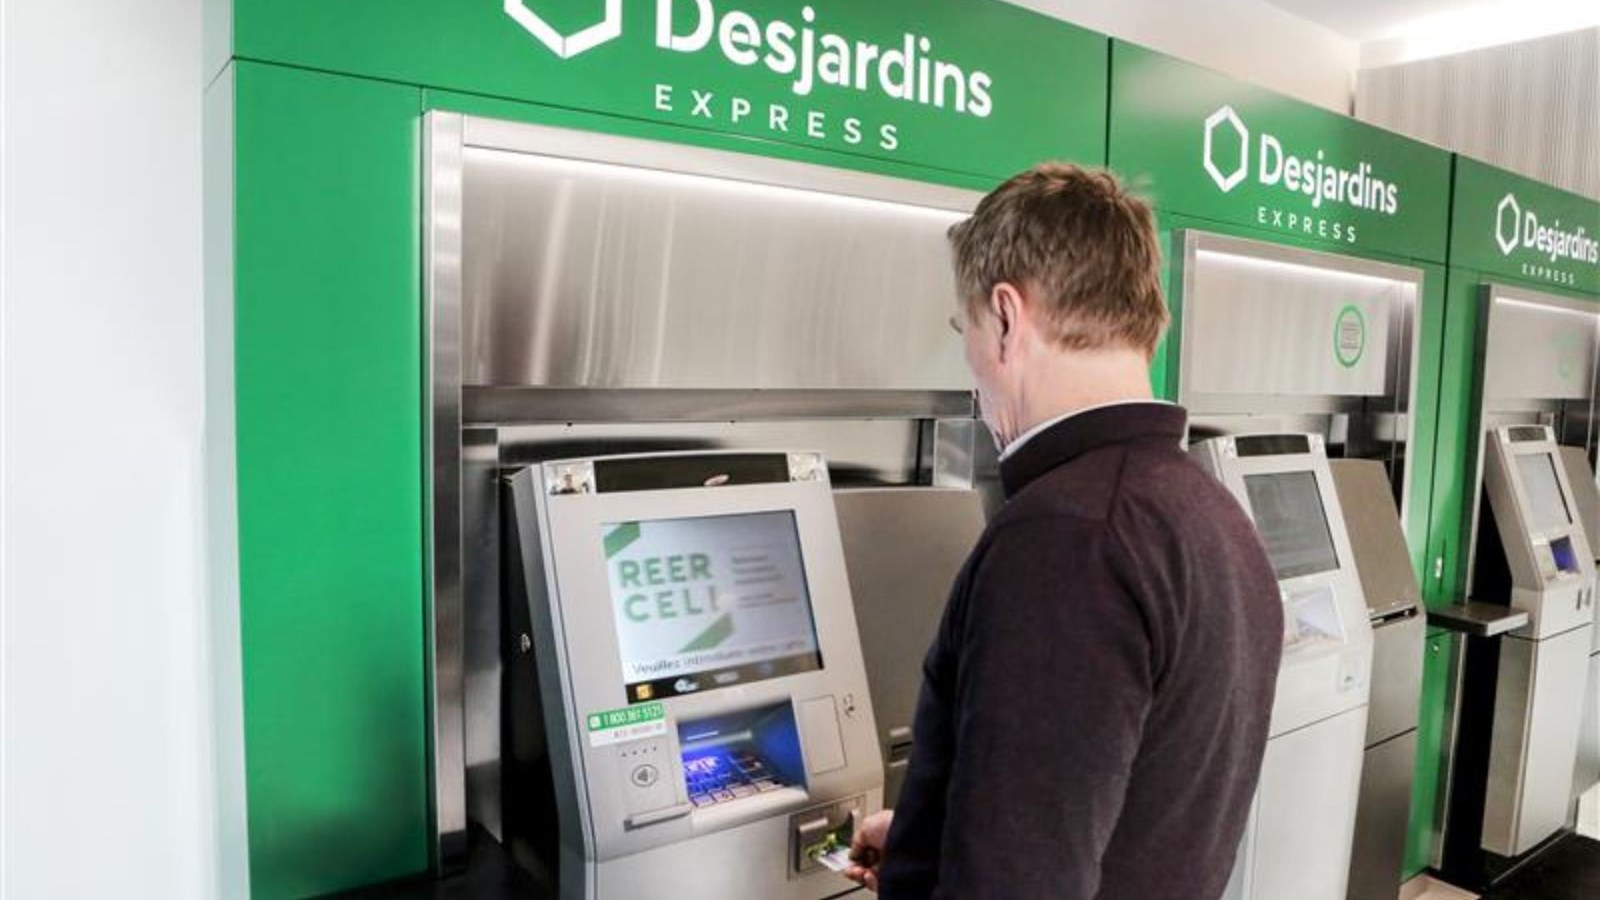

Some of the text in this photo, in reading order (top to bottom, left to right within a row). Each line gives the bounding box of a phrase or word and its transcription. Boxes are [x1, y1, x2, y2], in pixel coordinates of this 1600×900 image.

[655, 0, 993, 117] Desjardins
[655, 84, 898, 150] EXPRESS
[1259, 133, 1398, 214] Desjardins
[1257, 206, 1356, 243] EXPRESS
[1523, 211, 1598, 263] Desjardins
[1522, 263, 1574, 285] EXPRESS
[618, 553, 712, 587] REER
